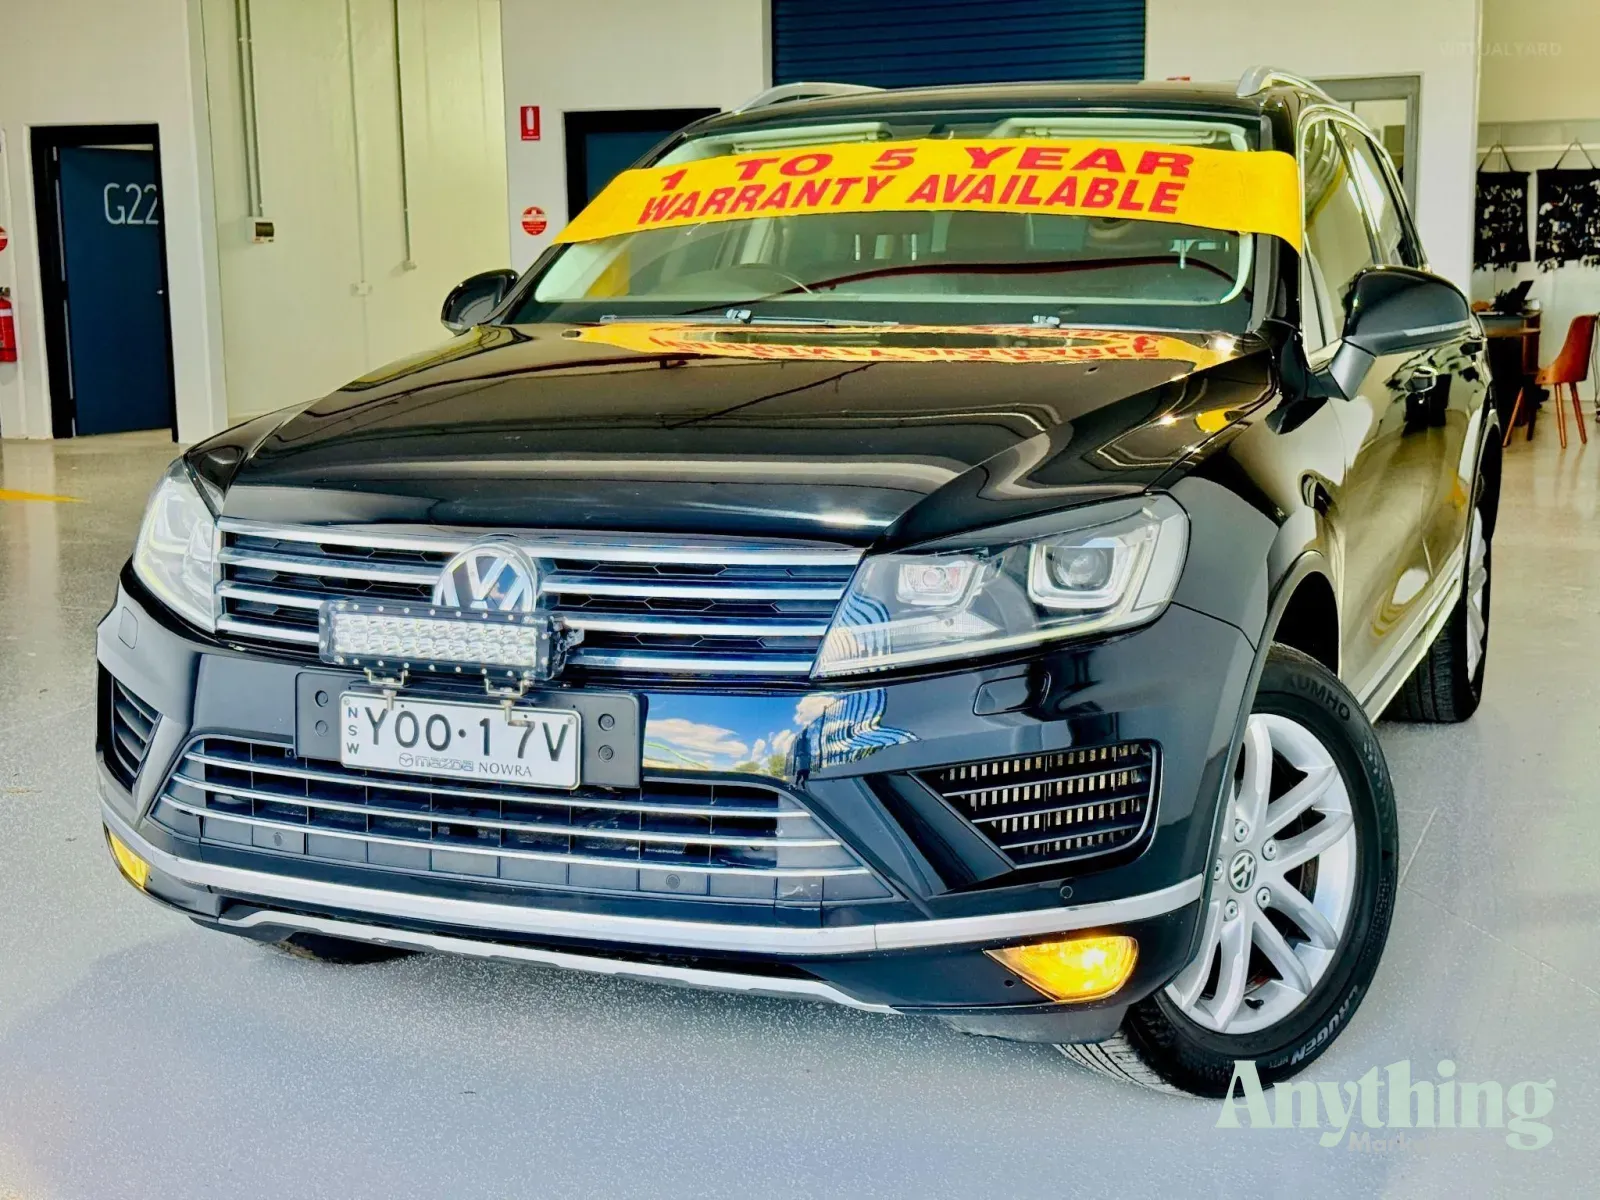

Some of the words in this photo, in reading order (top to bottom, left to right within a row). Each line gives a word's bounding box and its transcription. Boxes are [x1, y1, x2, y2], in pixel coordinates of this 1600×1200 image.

[661, 169, 688, 191] 1
[734, 153, 833, 182] TO
[869, 147, 918, 171] 5
[963, 146, 1194, 178] YEAR
[103, 182, 160, 225] G22
[637, 174, 896, 226] WARRANTY
[906, 173, 1186, 214] AVAILABLE
[478, 762, 533, 777] NOWRA
